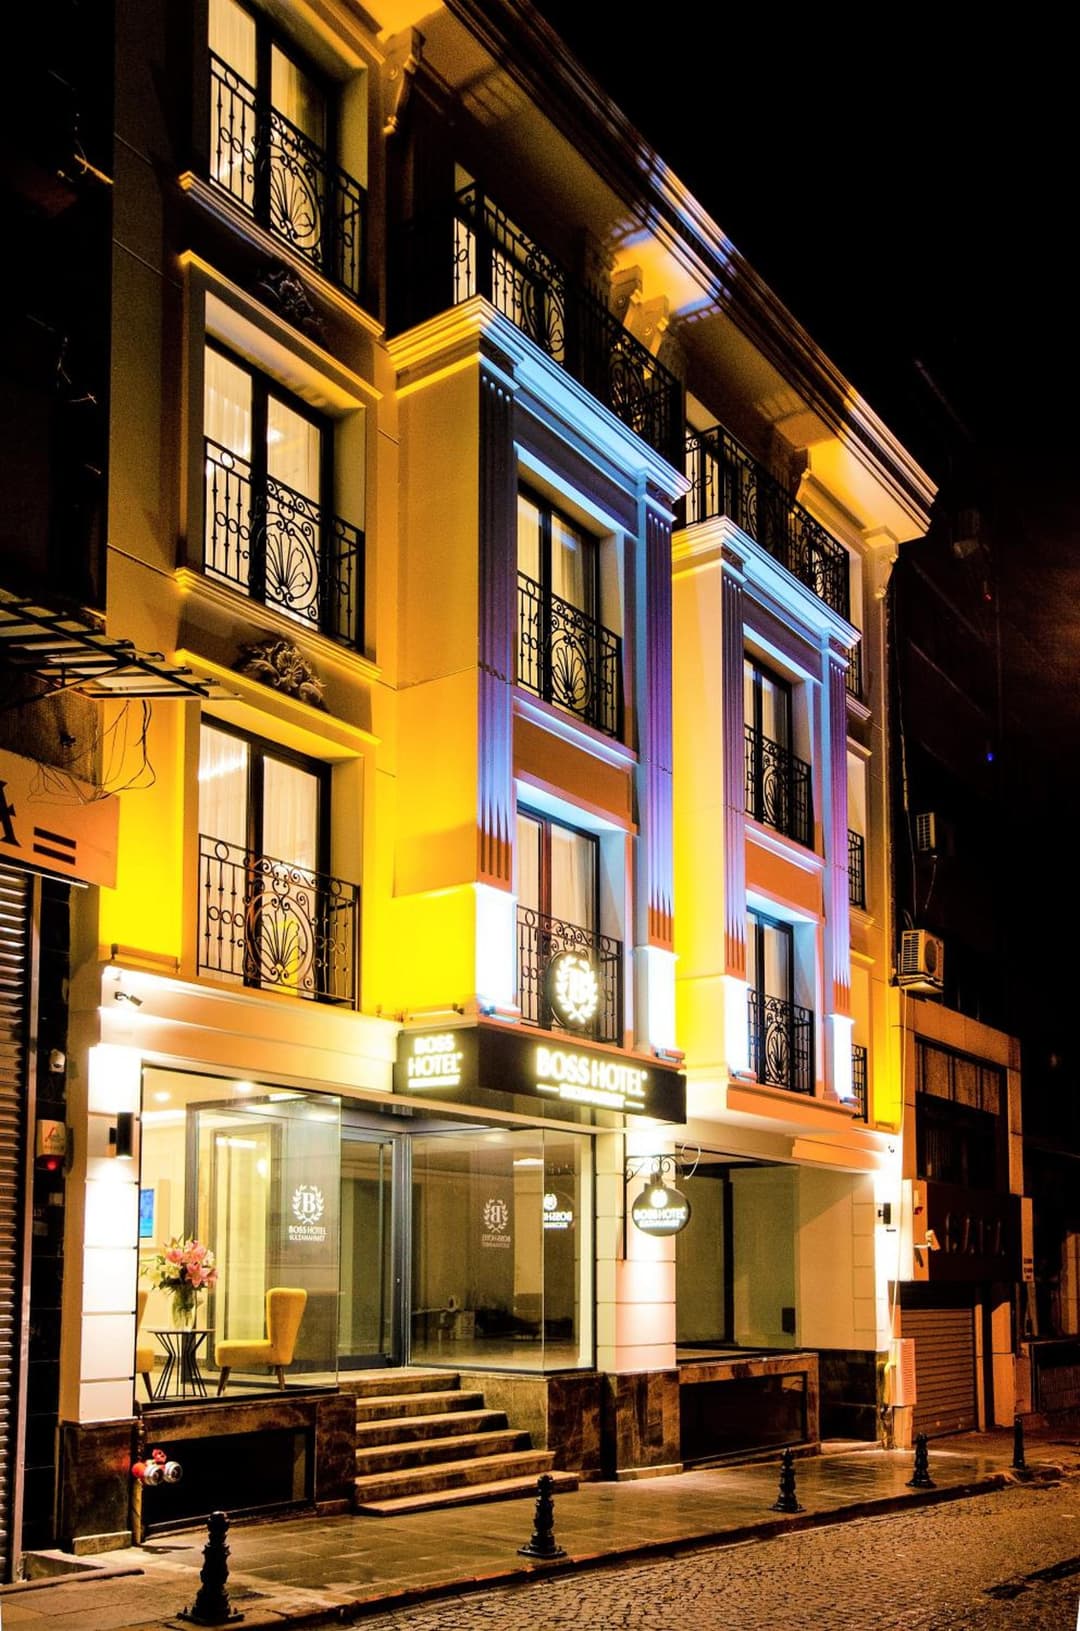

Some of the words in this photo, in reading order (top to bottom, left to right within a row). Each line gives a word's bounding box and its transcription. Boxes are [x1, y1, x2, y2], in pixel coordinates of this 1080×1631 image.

[414, 1034, 455, 1054] BOSS
[408, 1054, 461, 1077] HOTEL
[536, 1046, 590, 1085] BOSS
[591, 1059, 646, 1096] HOTEL
[302, 1192, 316, 1213] B
